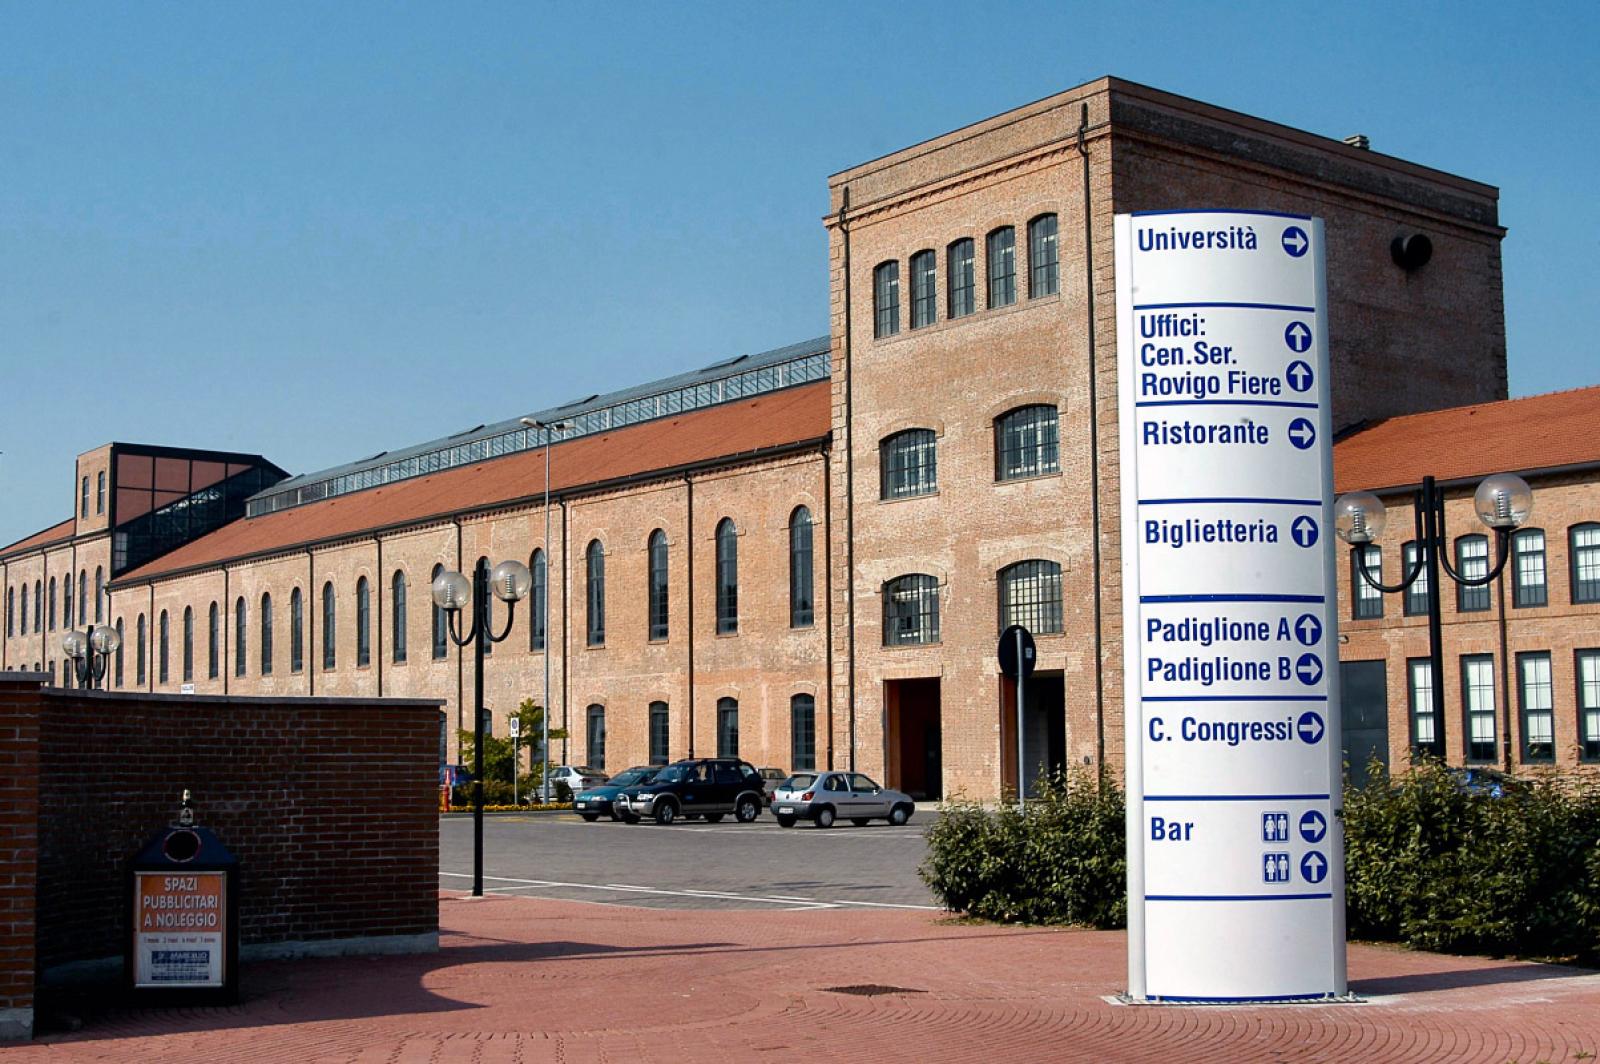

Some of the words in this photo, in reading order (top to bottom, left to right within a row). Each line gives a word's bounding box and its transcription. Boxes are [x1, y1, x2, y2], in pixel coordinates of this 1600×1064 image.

[1138, 225, 1258, 252] Università
[1140, 313, 1206, 338] Uffici:
[1140, 341, 1237, 367] Cen.Ser.
[1141, 371, 1221, 399] Rovigo
[1228, 370, 1282, 396] Fiere
[1143, 420, 1269, 445] Ristorante
[1145, 518, 1278, 549] Biglietteria
[1147, 616, 1270, 646] Padiglione
[1276, 616, 1292, 642] A
[1148, 656, 1271, 686] Padiglione
[1278, 656, 1292, 681] B
[1148, 717, 1172, 742] C.
[1181, 716, 1293, 747] Congressi
[1151, 816, 1194, 841] Bar
[164, 877, 197, 892] SPAZI
[143, 895, 218, 909] PUBBLICITARI
[144, 913, 152, 927] A
[156, 913, 217, 927] NOLEGGIO
